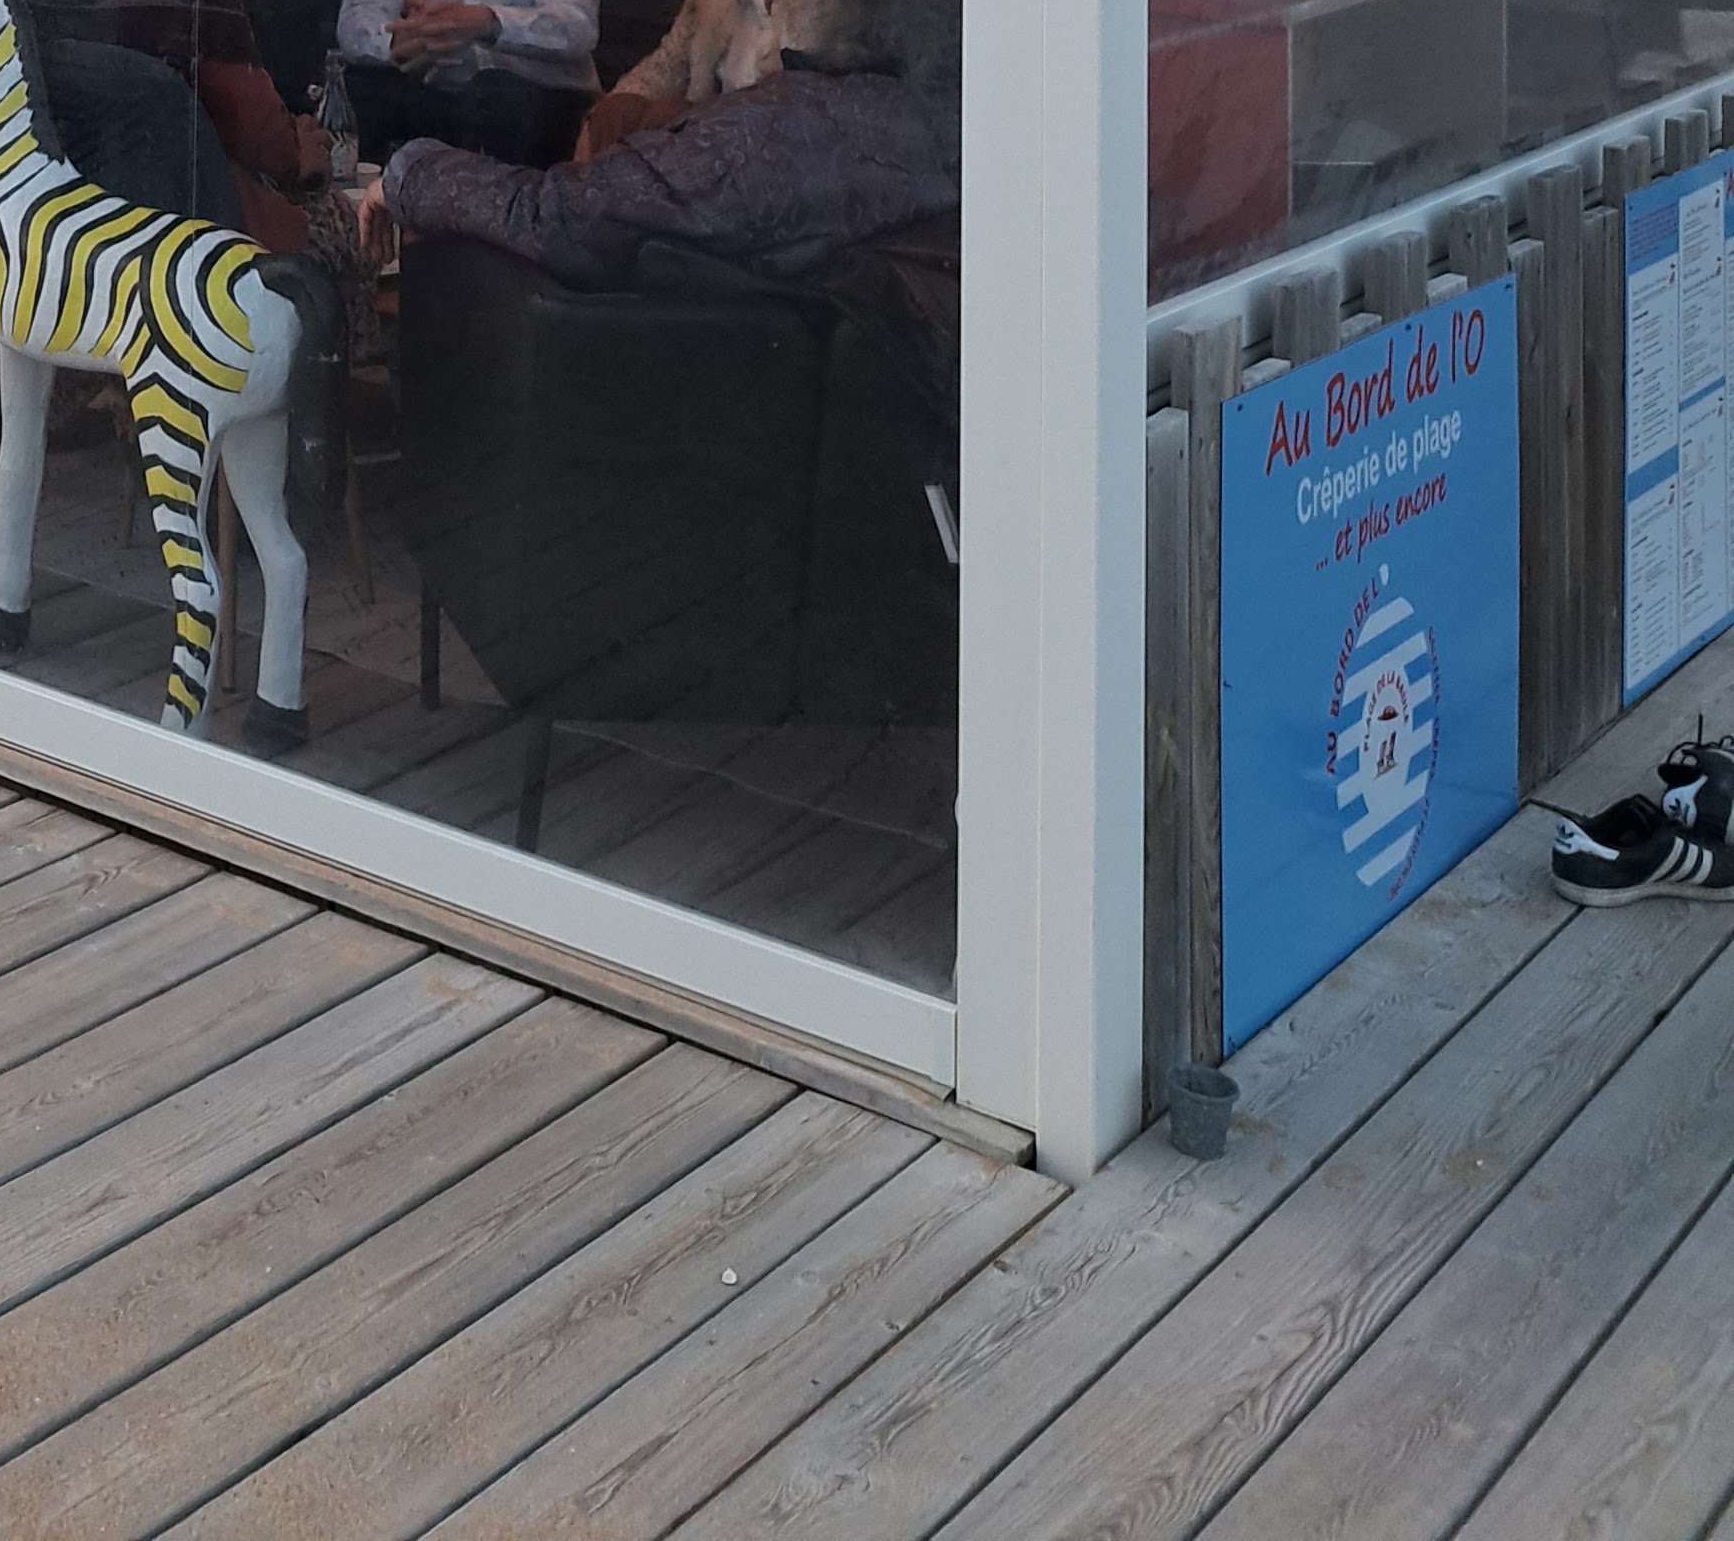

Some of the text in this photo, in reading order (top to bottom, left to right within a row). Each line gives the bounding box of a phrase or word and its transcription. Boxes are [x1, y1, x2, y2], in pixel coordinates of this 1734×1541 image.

[1265, 309, 1485, 477] Au Bord de l'O
[1296, 409, 1462, 525] Crêperie de plage
[1335, 519, 1353, 562] et
[1357, 499, 1390, 564] plus
[1395, 472, 1447, 526] encore
[1353, 588, 1371, 628] DE
[1329, 627, 1355, 719] BORD
[1325, 731, 1338, 776] AU
